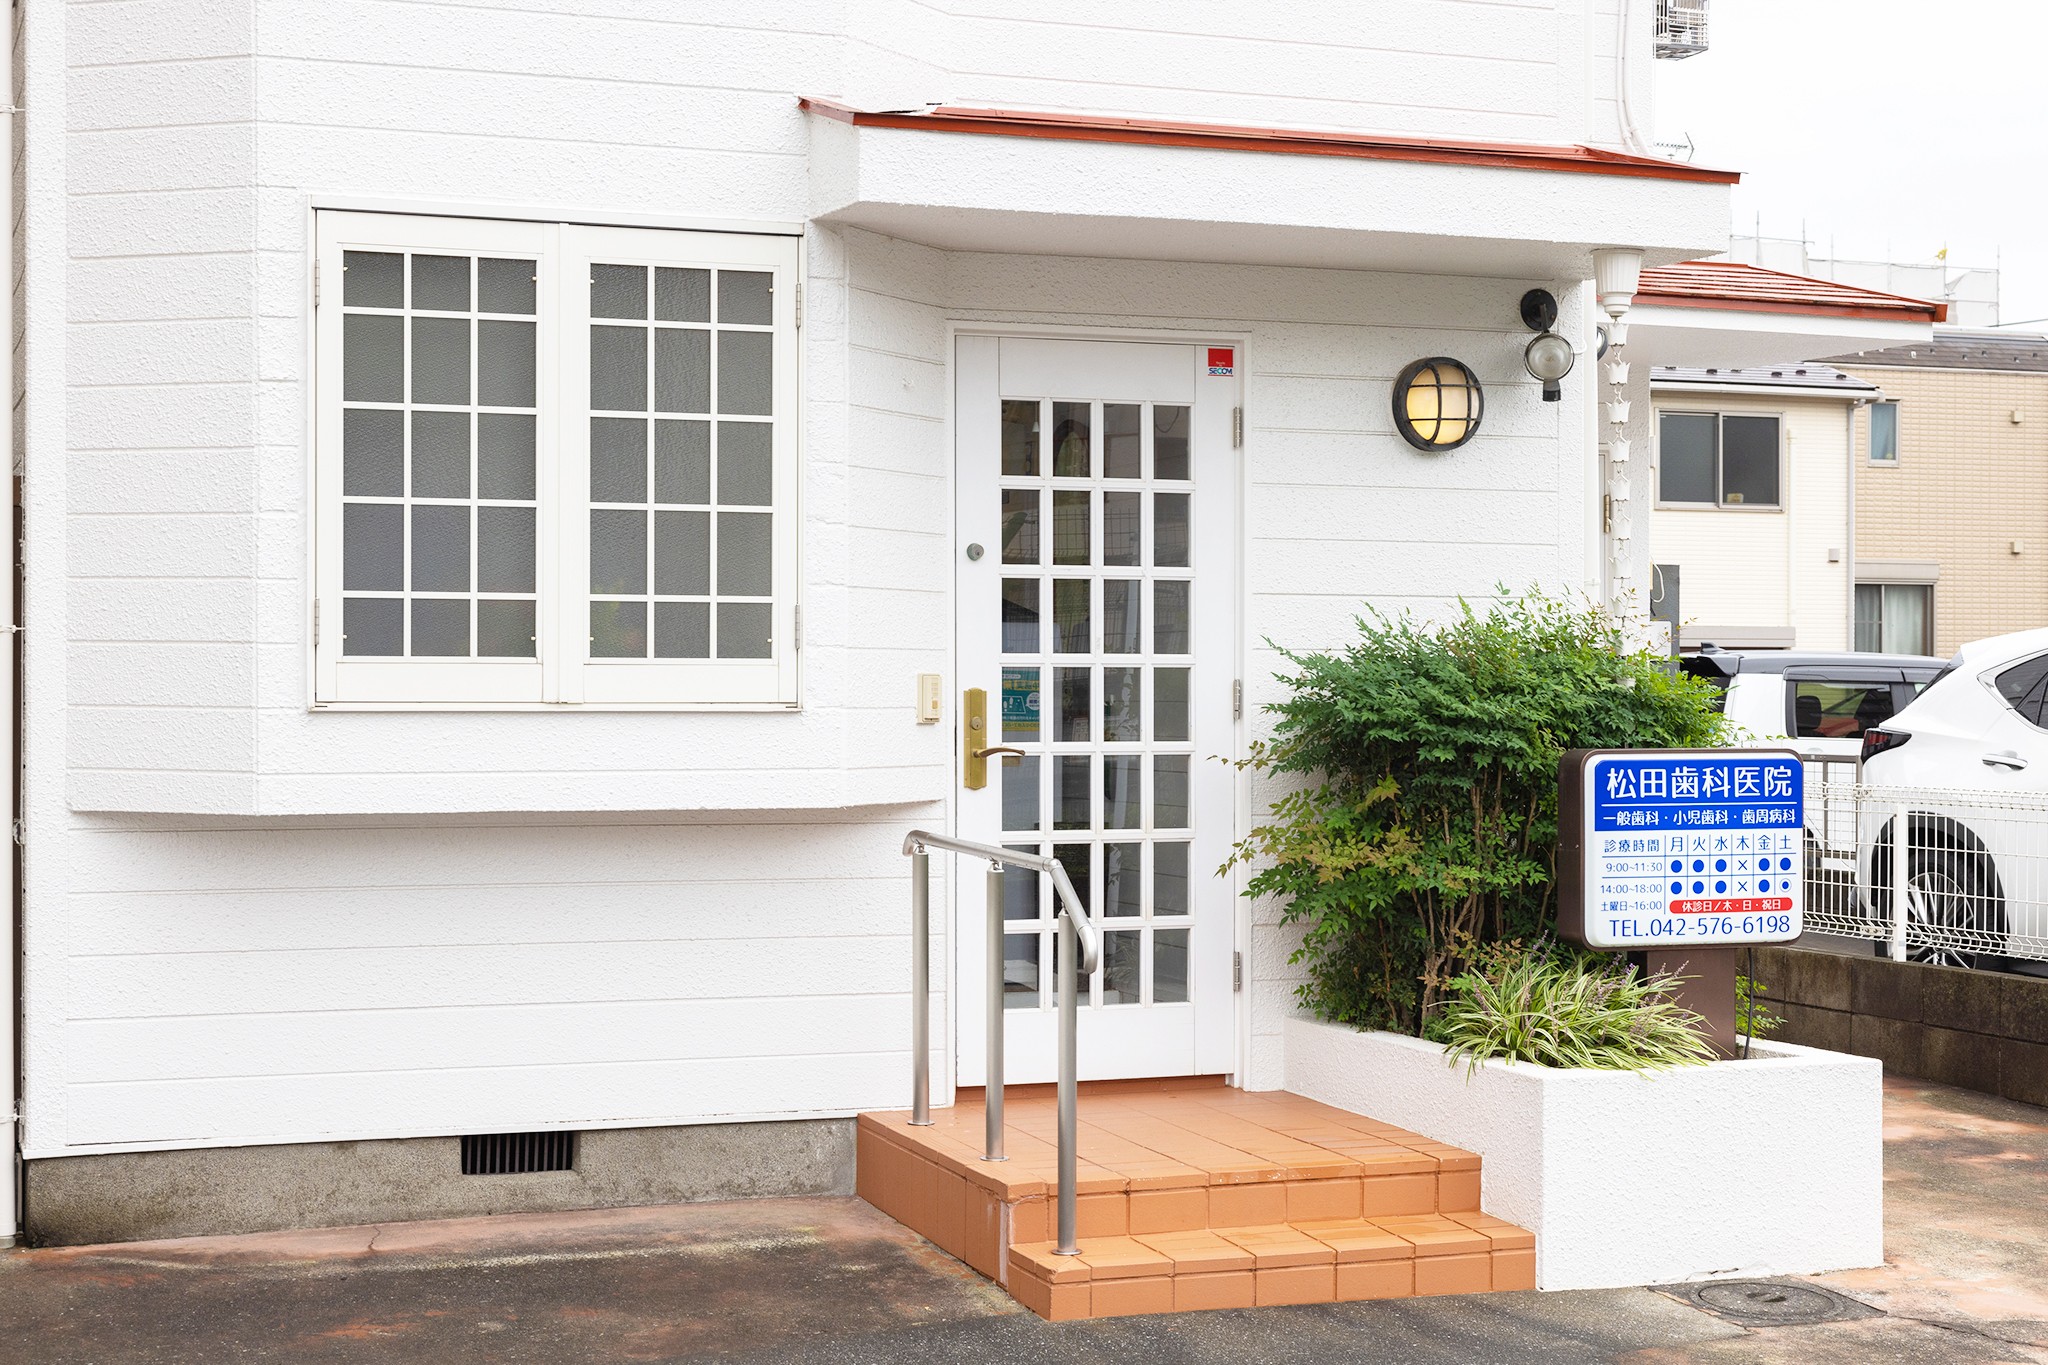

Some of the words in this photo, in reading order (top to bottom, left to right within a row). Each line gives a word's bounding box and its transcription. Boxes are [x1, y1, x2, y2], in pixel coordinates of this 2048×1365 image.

[1606, 765, 1793, 799] 松田歯科医院
[1604, 839, 1660, 853] 診療時間
[1670, 836, 1683, 852] 月
[1692, 836, 1706, 851] 火
[1714, 835, 1729, 851] 水
[1736, 835, 1750, 850] 木
[1757, 834, 1771, 850] 金
[1779, 834, 1792, 850] 土
[1609, 915, 1790, 937] TEL.042-576-6198
